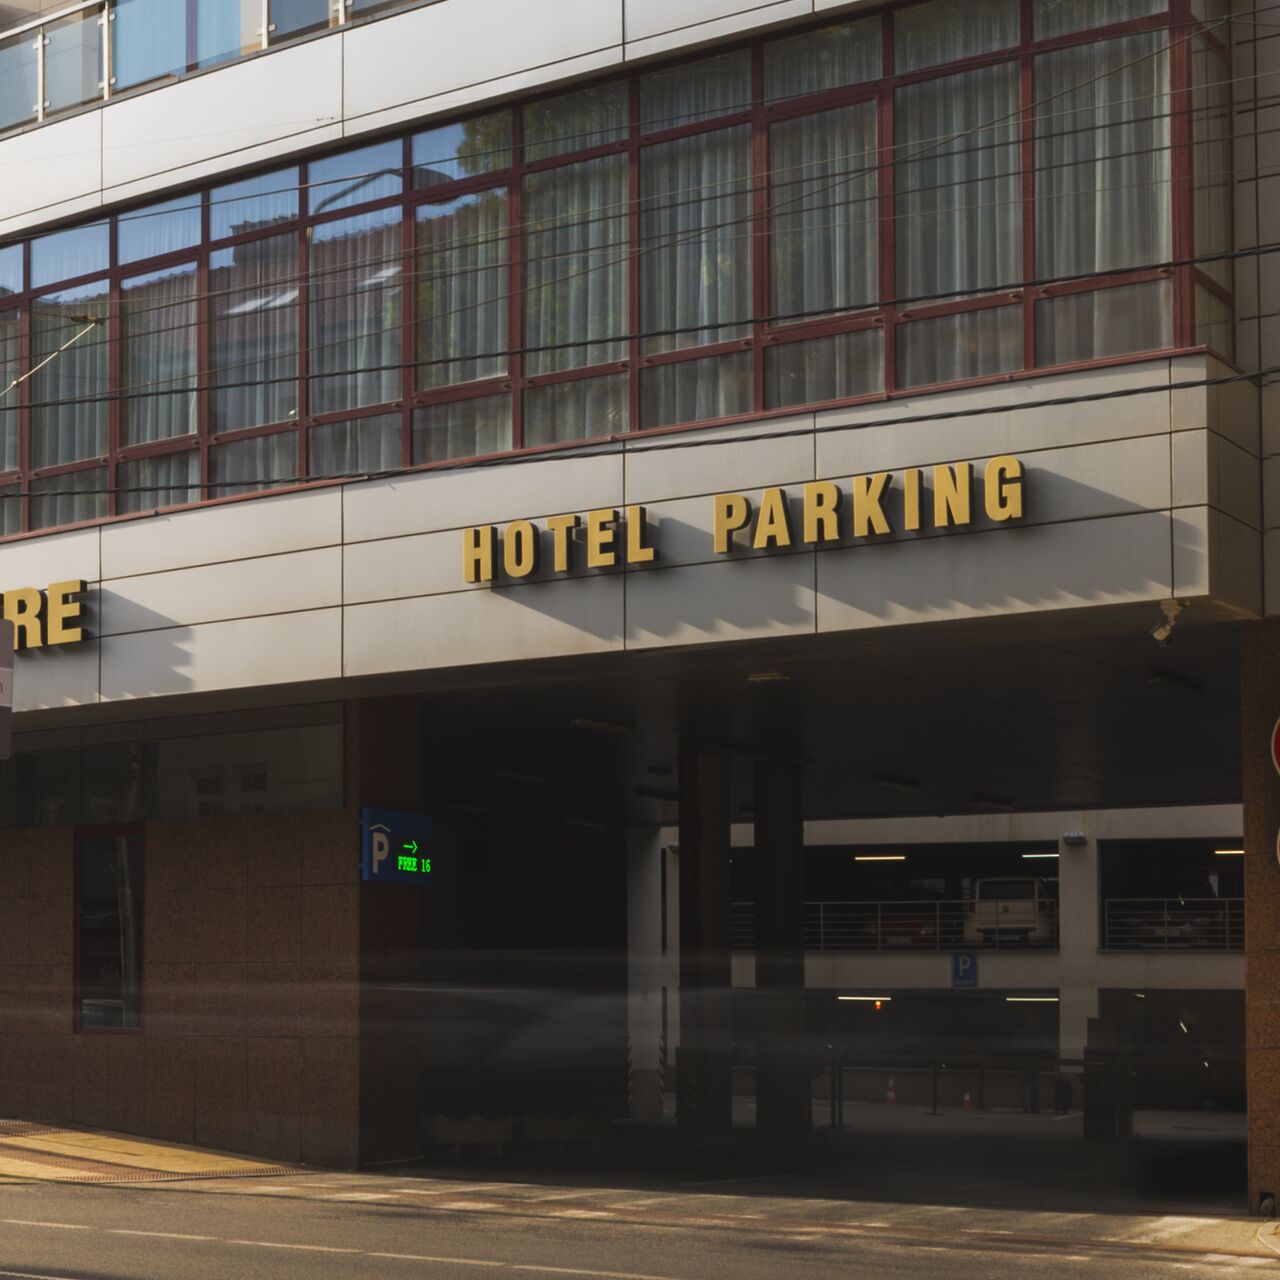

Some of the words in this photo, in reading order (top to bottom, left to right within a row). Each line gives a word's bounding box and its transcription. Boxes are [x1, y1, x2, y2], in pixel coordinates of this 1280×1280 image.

[463, 505, 654, 583] HOTEL
[713, 455, 1023, 554] PARKING
[398, 856, 418, 871] FREE
[421, 858, 432, 872] 16
